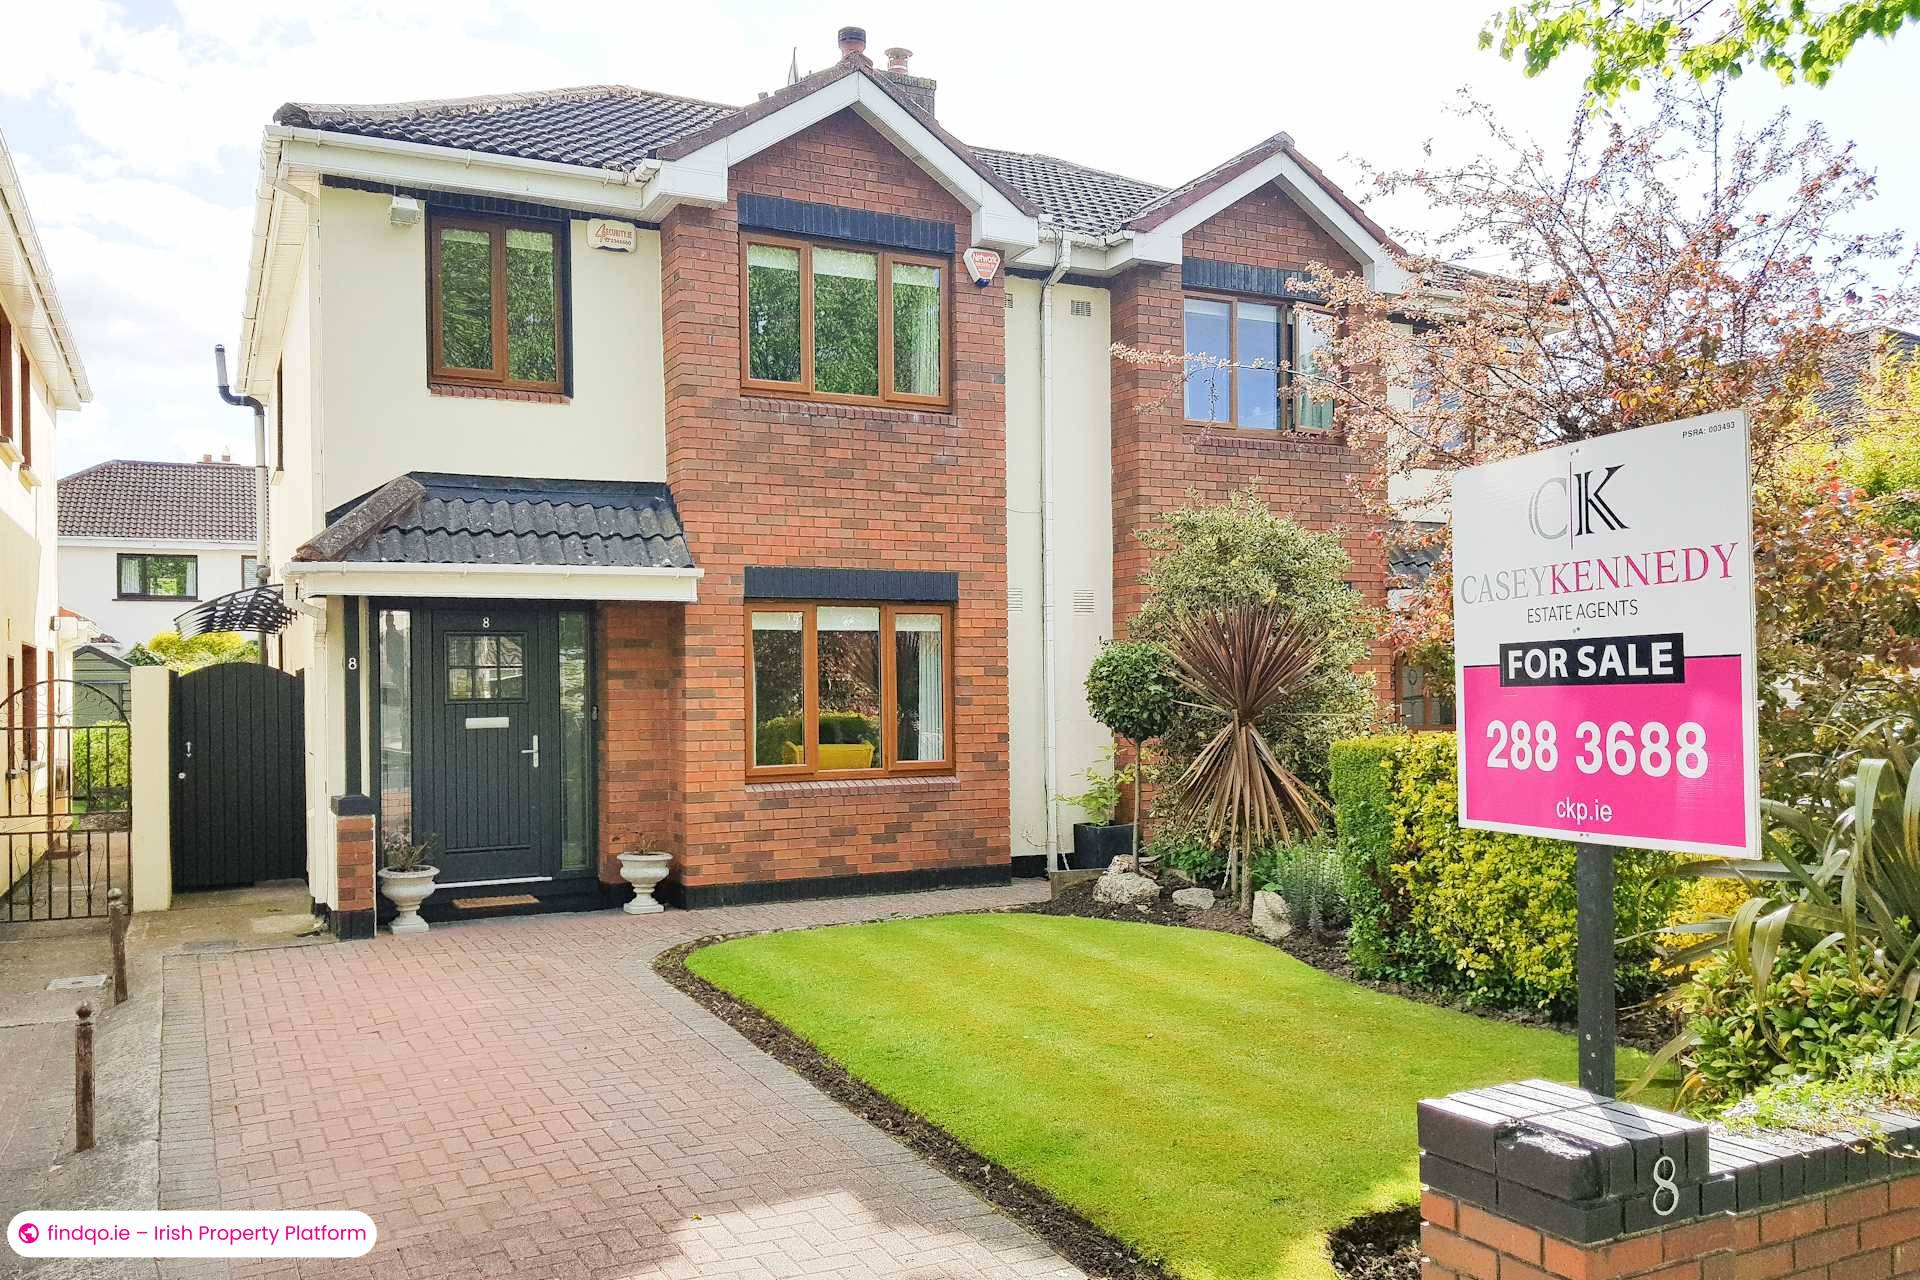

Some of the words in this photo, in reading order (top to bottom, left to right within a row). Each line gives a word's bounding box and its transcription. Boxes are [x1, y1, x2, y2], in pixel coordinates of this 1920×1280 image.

[482, 616, 490, 629] 8
[1527, 605, 1573, 624] ESTATE
[1576, 599, 1639, 619] AGENTS
[348, 657, 358, 671] 8
[1507, 648, 1569, 680] FOR
[1577, 641, 1674, 678] SALE
[1486, 719, 1559, 772] 288
[1575, 720, 1709, 779] 3688
[1556, 797, 1613, 825] ckp.ie
[1652, 1155, 1680, 1216] 8
